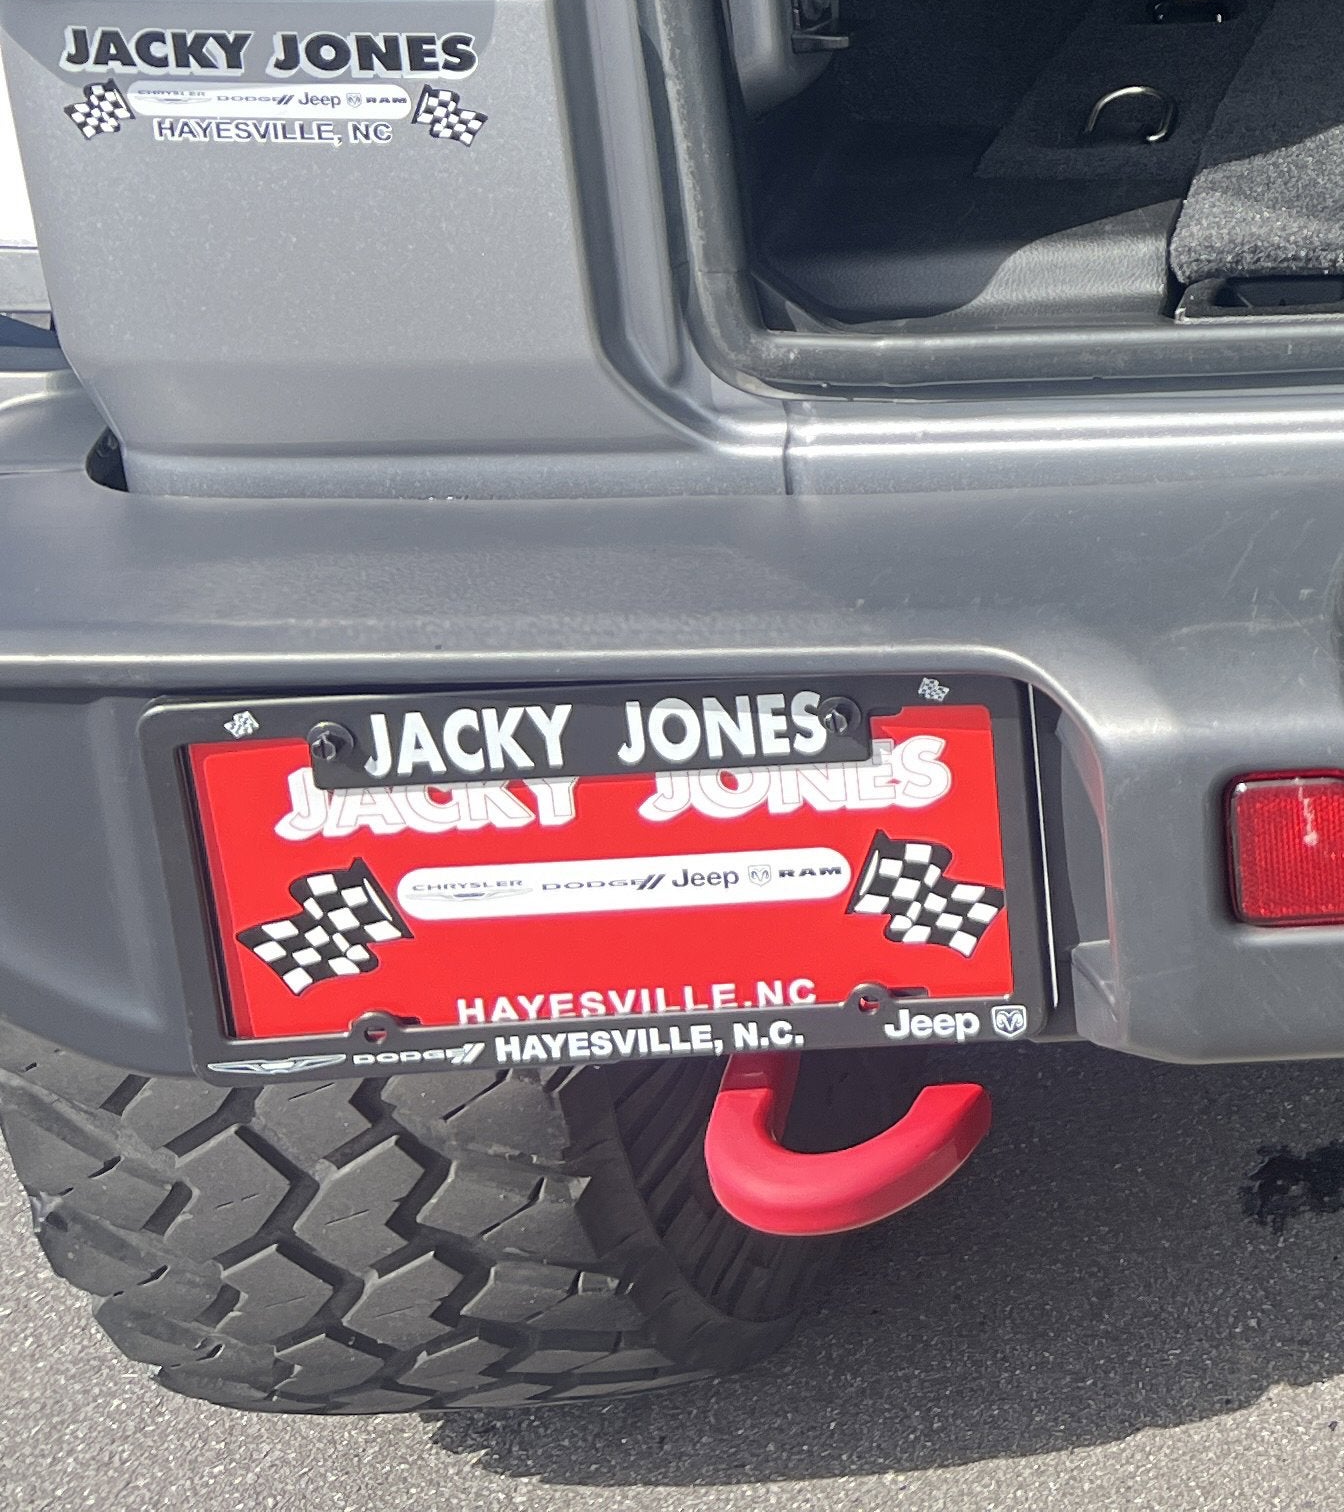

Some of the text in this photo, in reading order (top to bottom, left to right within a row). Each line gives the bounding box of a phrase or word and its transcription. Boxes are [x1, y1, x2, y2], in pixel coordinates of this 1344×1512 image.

[60, 26, 479, 78] JACKY JONES
[298, 91, 342, 109] Jeep
[365, 96, 408, 104] RAM
[154, 118, 393, 147] HAYESVILLE, NC
[364, 691, 827, 778] JACKY JONES
[273, 735, 952, 841] JACKY JONES
[412, 866, 842, 892] CHRYSLER DODGE Jeep RAM
[352, 1019, 804, 1067] DODGE HAYESVILLE, N.C.
[884, 1008, 980, 1042] Jeep
